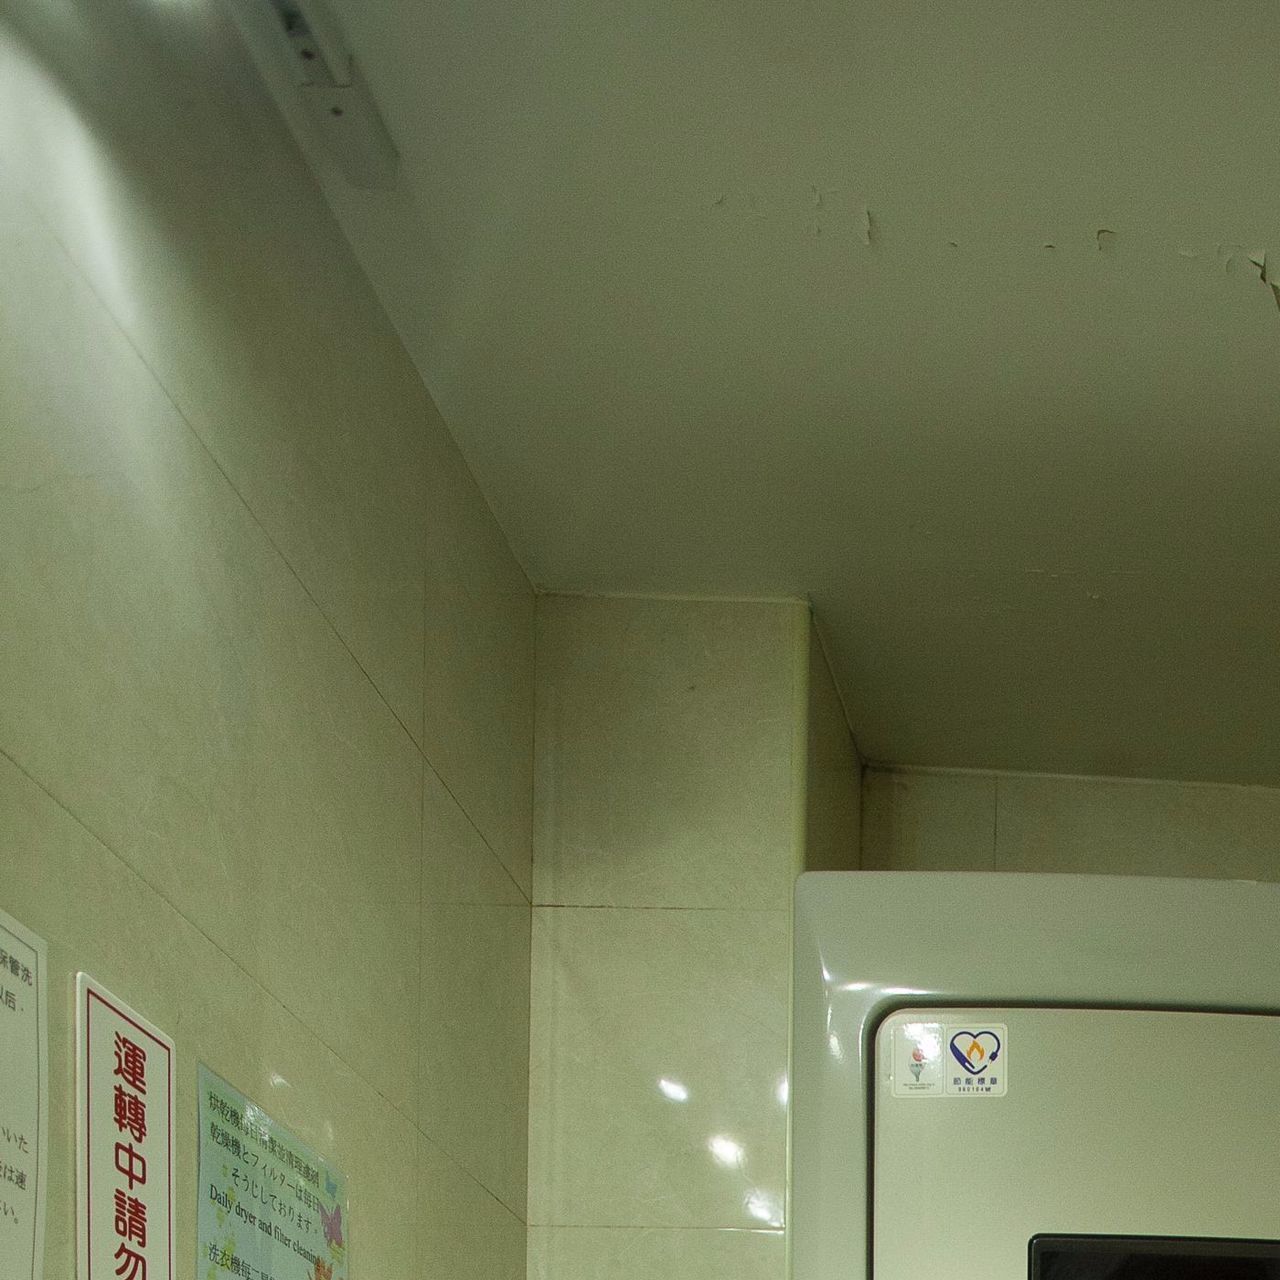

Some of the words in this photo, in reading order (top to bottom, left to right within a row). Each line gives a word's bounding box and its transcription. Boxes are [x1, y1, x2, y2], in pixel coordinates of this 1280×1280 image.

[210, 1184, 233, 1213] Daily
[235, 1201, 256, 1227] dryer
[258, 1217, 272, 1236] and
